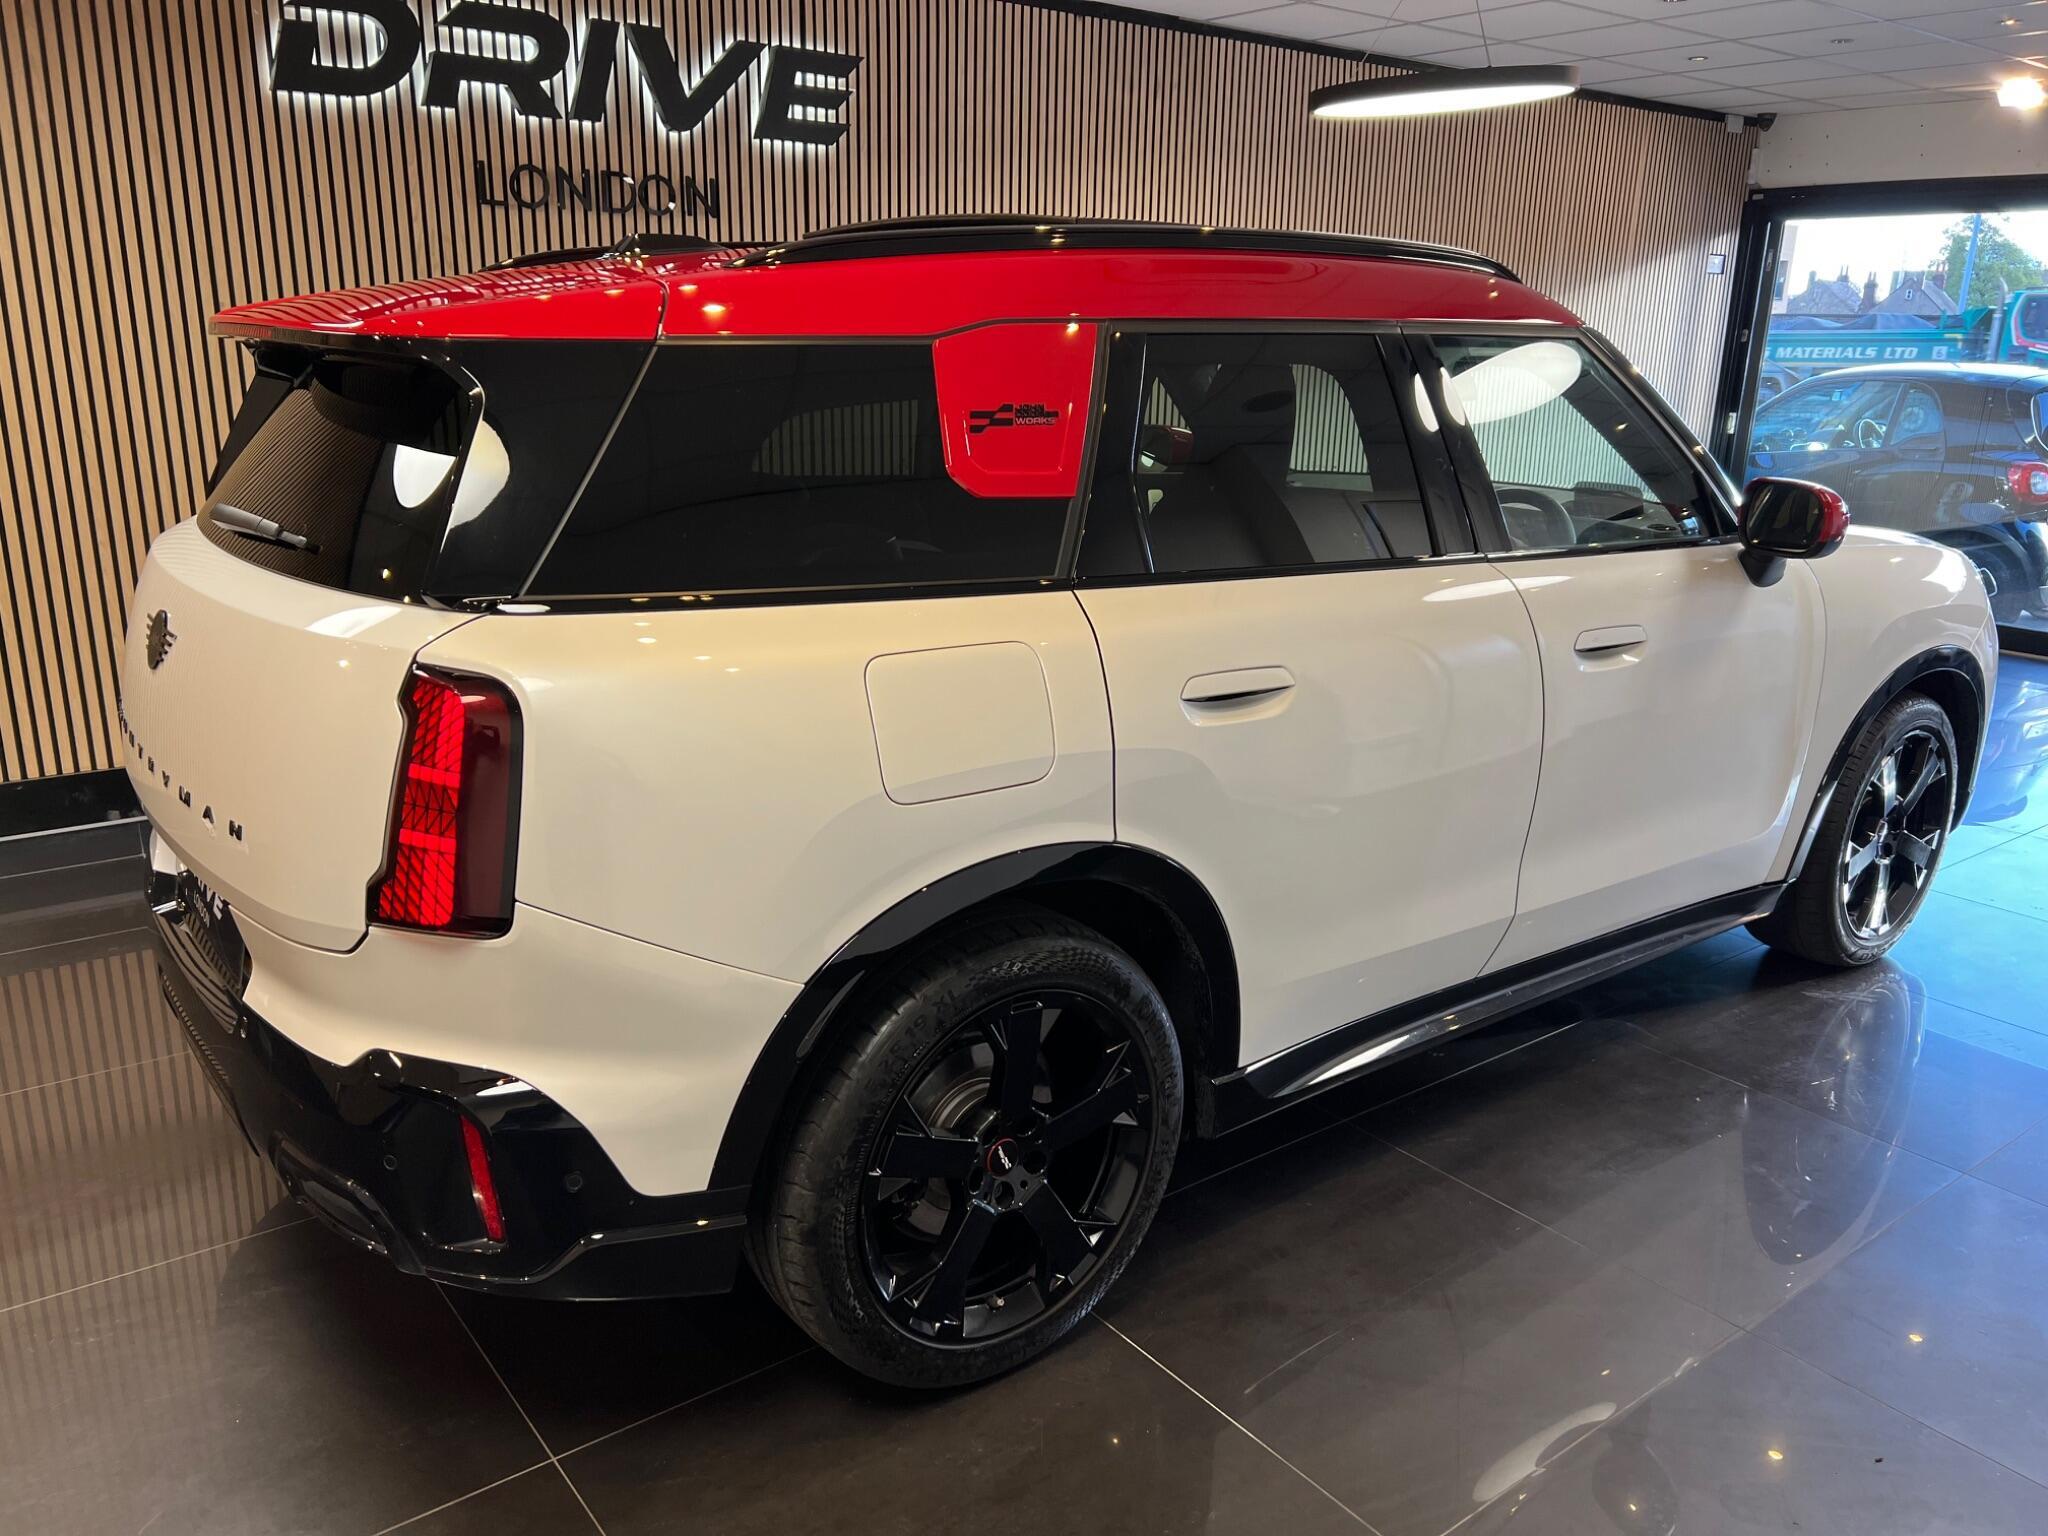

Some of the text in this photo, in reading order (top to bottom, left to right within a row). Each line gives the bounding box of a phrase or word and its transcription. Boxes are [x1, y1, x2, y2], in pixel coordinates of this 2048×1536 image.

[271, 0, 864, 146] DRIVE
[476, 159, 718, 219] LONDON
[1775, 346, 1877, 359] MATERIALS
[1883, 347, 1918, 359] LTD
[1015, 417, 1056, 425] WORKS
